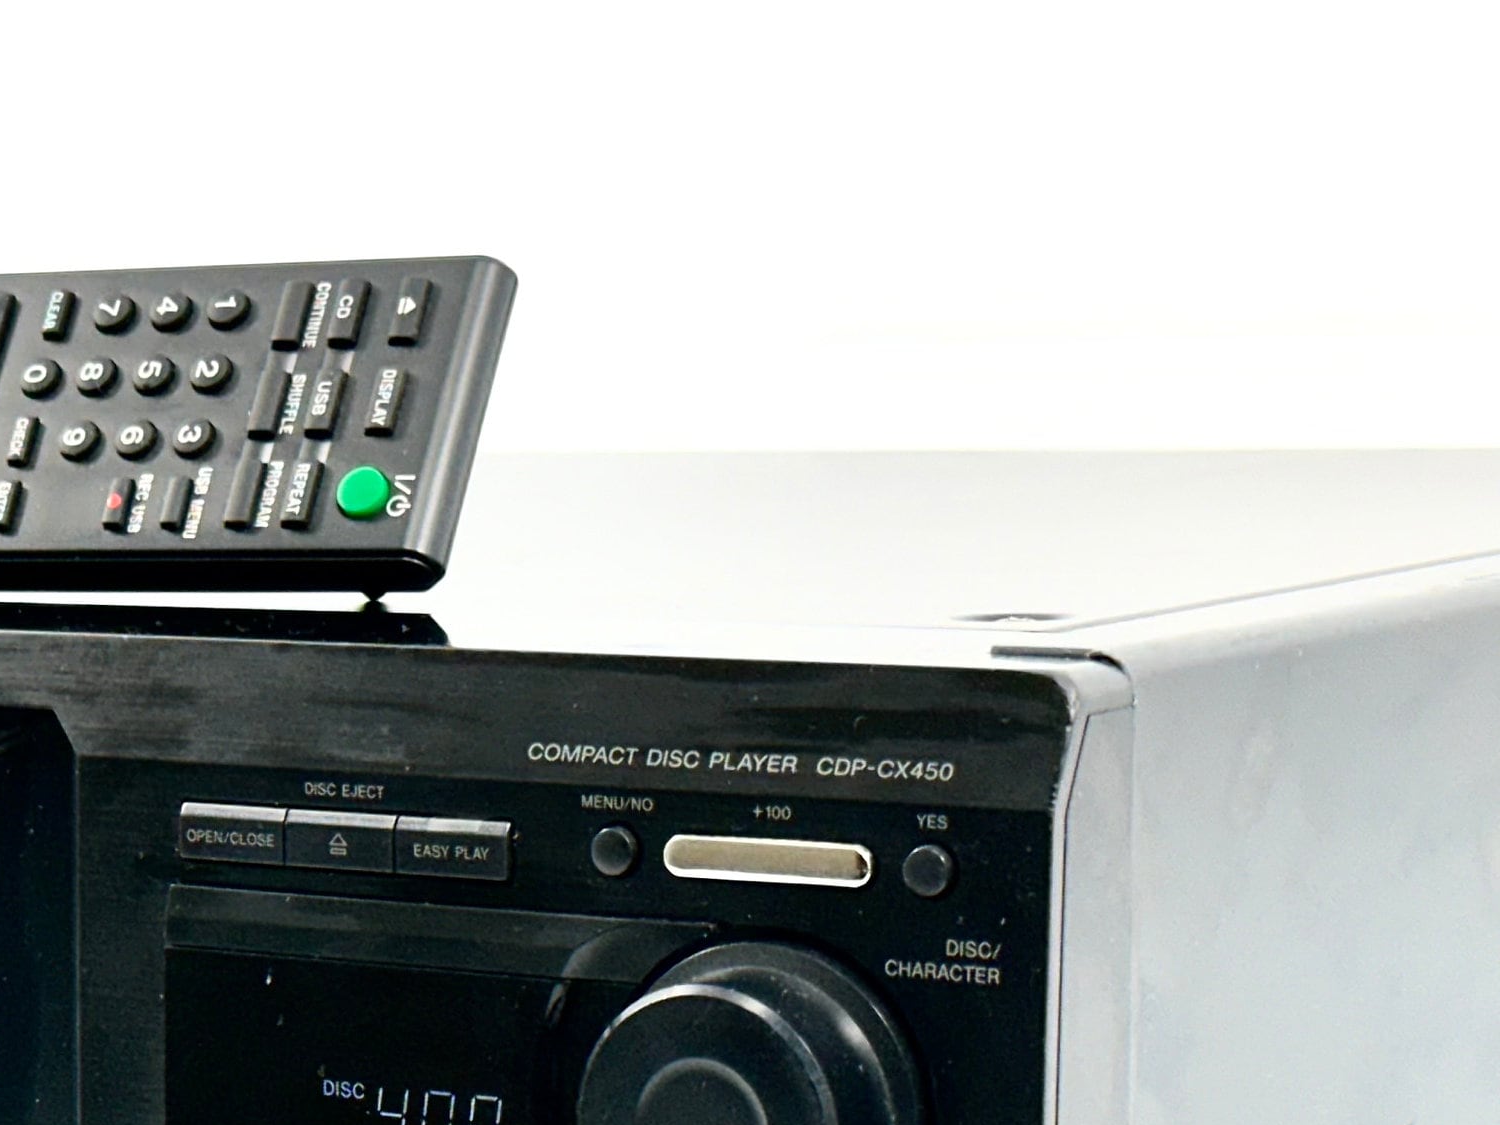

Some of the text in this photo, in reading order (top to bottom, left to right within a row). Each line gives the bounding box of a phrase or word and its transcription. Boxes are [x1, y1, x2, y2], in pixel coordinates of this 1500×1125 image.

[98, 299, 121, 317] 7
[156, 296, 179, 316] 4
[214, 296, 237, 309] 1
[336, 295, 354, 319] CD
[80, 362, 104, 381] 8
[138, 360, 163, 379] 5
[195, 360, 219, 378] 2
[279, 374, 307, 435] SHUFFLE
[312, 381, 332, 416] USB
[371, 369, 397, 426] DISPLAY
[62, 427, 86, 447] 9
[120, 426, 144, 445] 6
[177, 425, 202, 444] 3
[285, 463, 311, 515] REPEAT
[527, 742, 954, 781] COMPACT DISC PLAYER CDP-CX450
[305, 782, 384, 799] DISC EJECT
[581, 794, 654, 812] MENU/NO
[753, 805, 792, 820] +100
[916, 814, 948, 830] YES
[186, 829, 275, 847] OPEN/CLOSE
[413, 843, 490, 861] EASY PLAY
[946, 938, 1001, 960] DISC/
[884, 958, 1000, 985] CHARACTER
[323, 1079, 365, 1099] DISC
